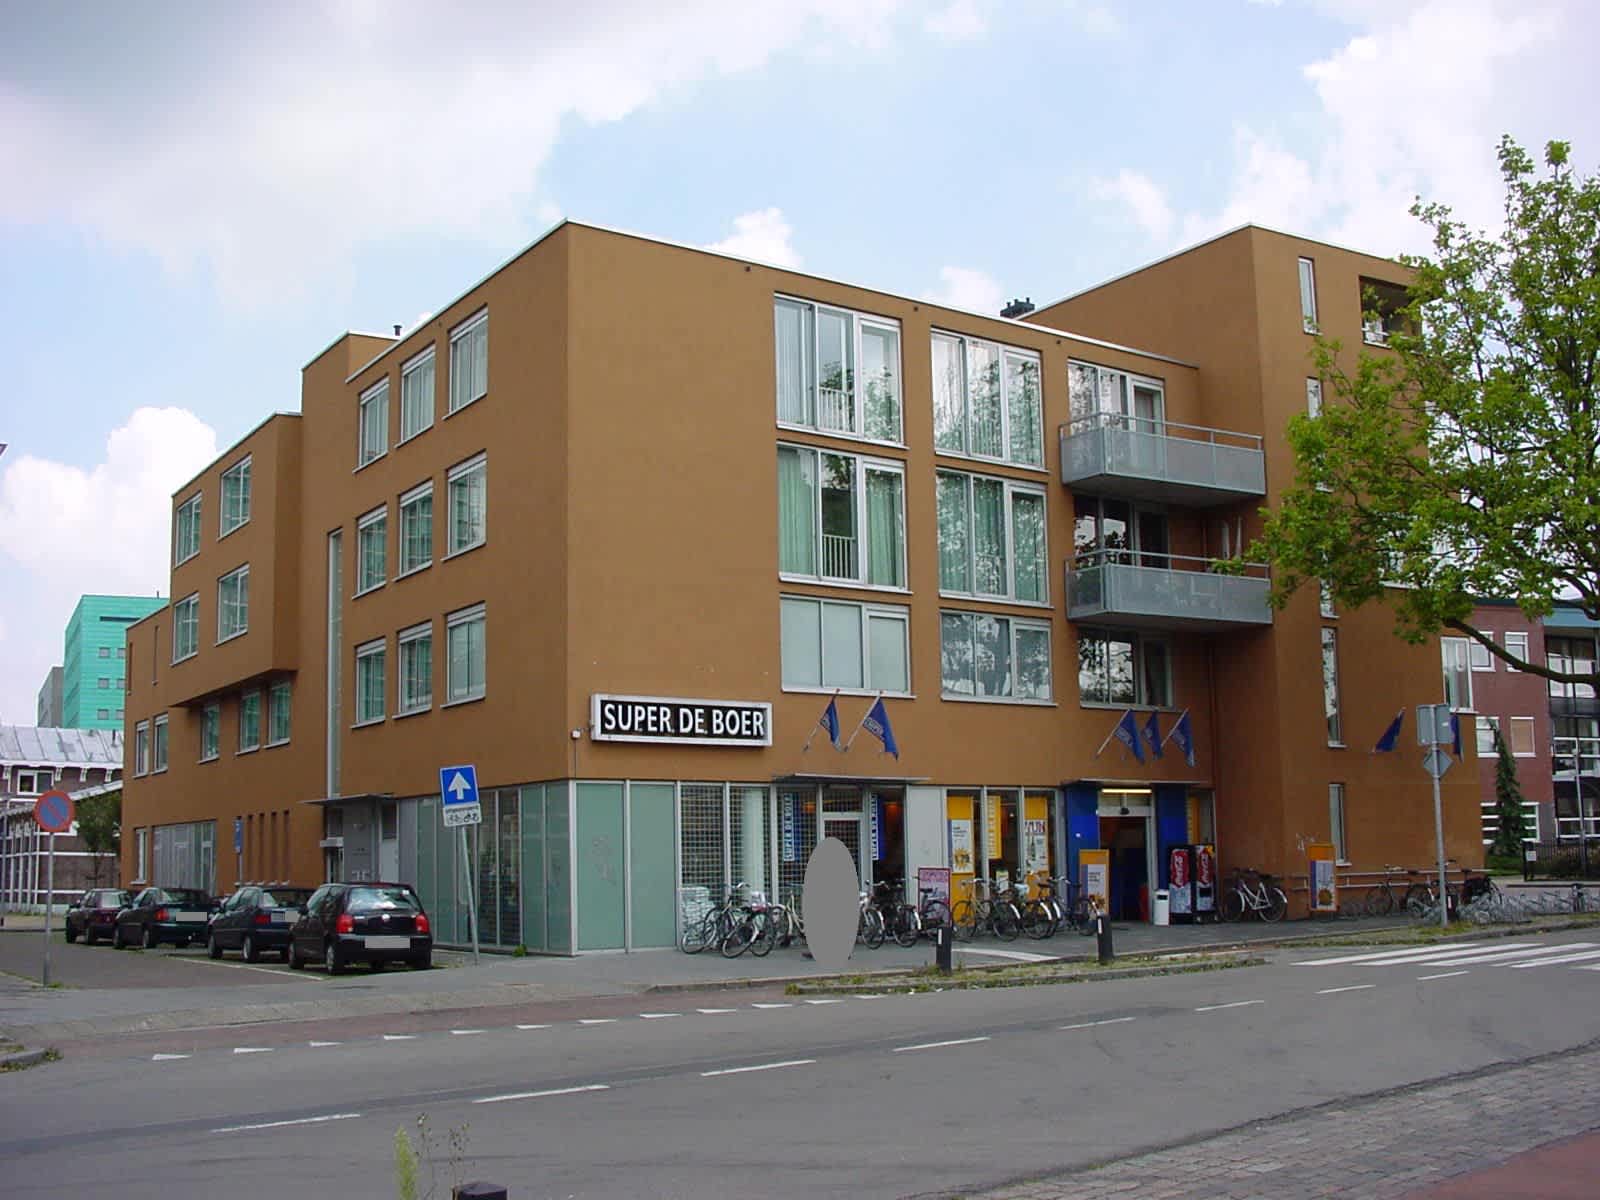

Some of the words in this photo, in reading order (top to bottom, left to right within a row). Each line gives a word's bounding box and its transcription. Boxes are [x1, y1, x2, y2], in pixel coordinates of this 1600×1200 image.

[604, 703, 672, 732] SUPER
[679, 707, 705, 734] DE
[712, 709, 764, 736] BOER
